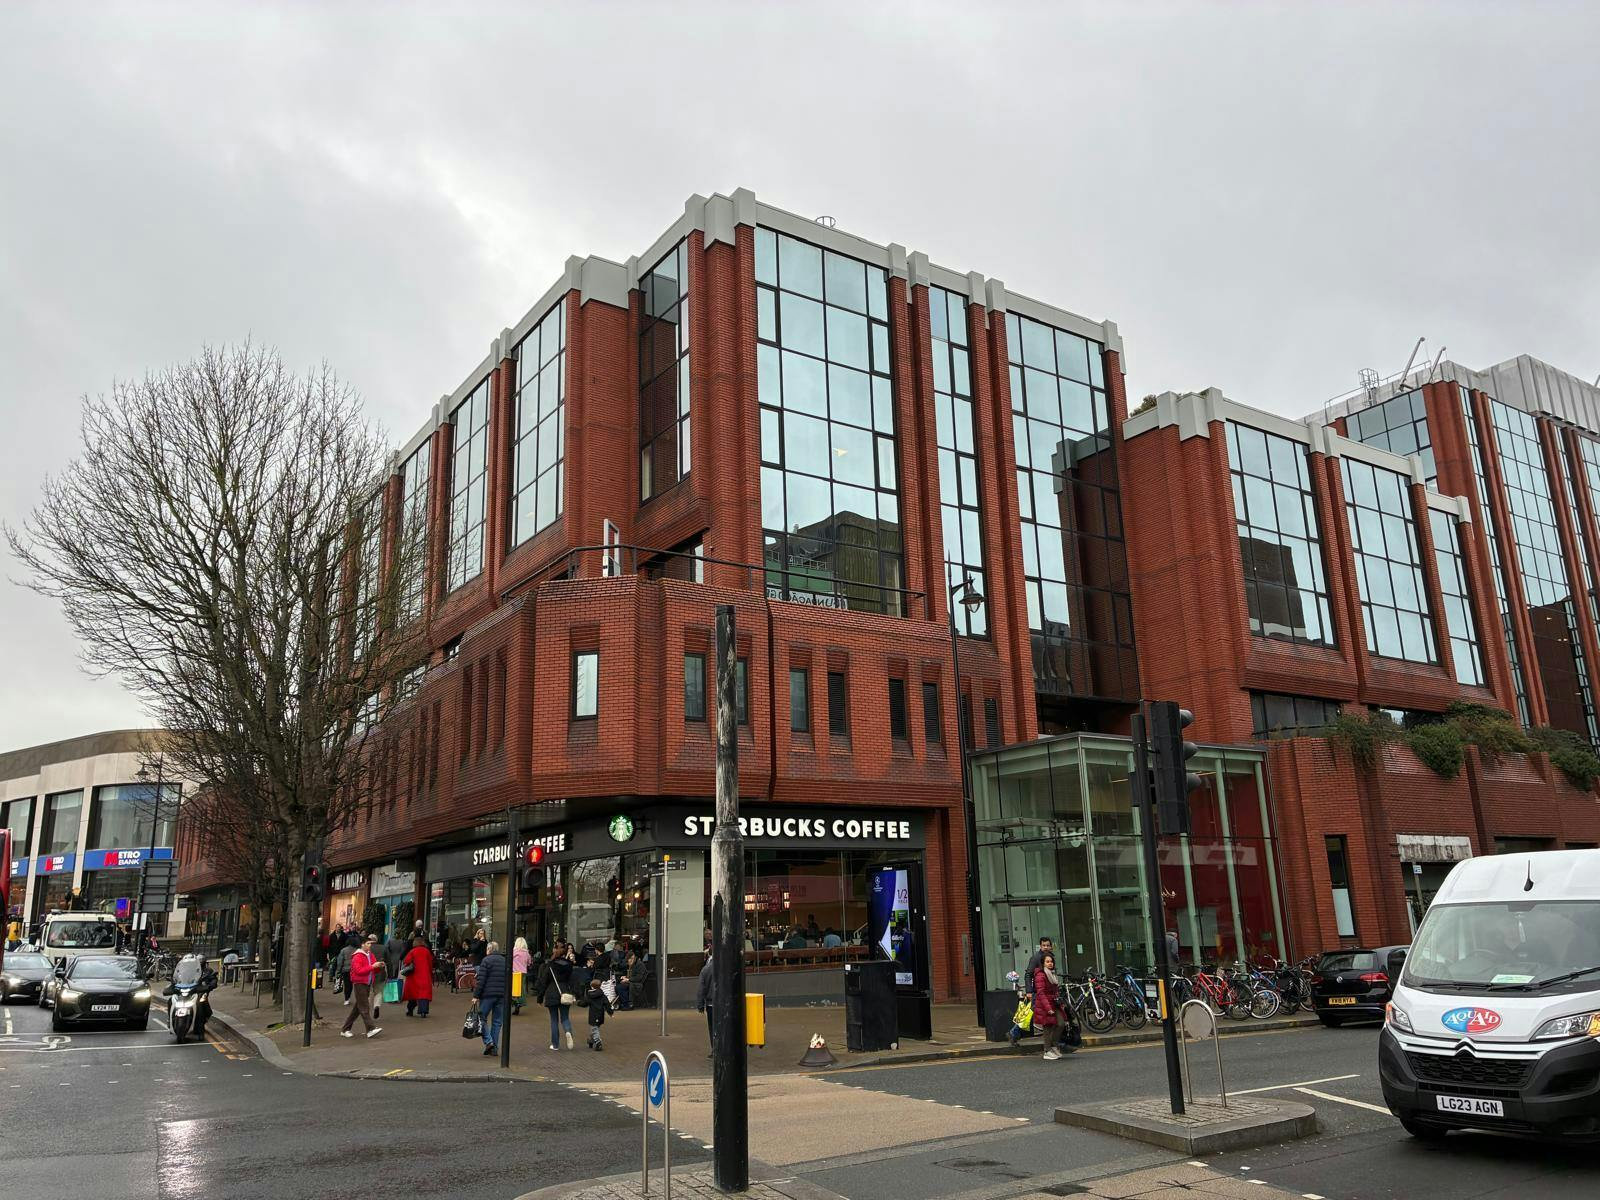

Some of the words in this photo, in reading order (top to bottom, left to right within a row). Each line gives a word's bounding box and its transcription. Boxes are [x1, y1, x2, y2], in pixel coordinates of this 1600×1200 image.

[684, 816, 826, 838] STRBUCKS
[832, 819, 910, 839] COFFEE
[1441, 1096, 1472, 1111] LG23
[1475, 1101, 1499, 1114] AGN
